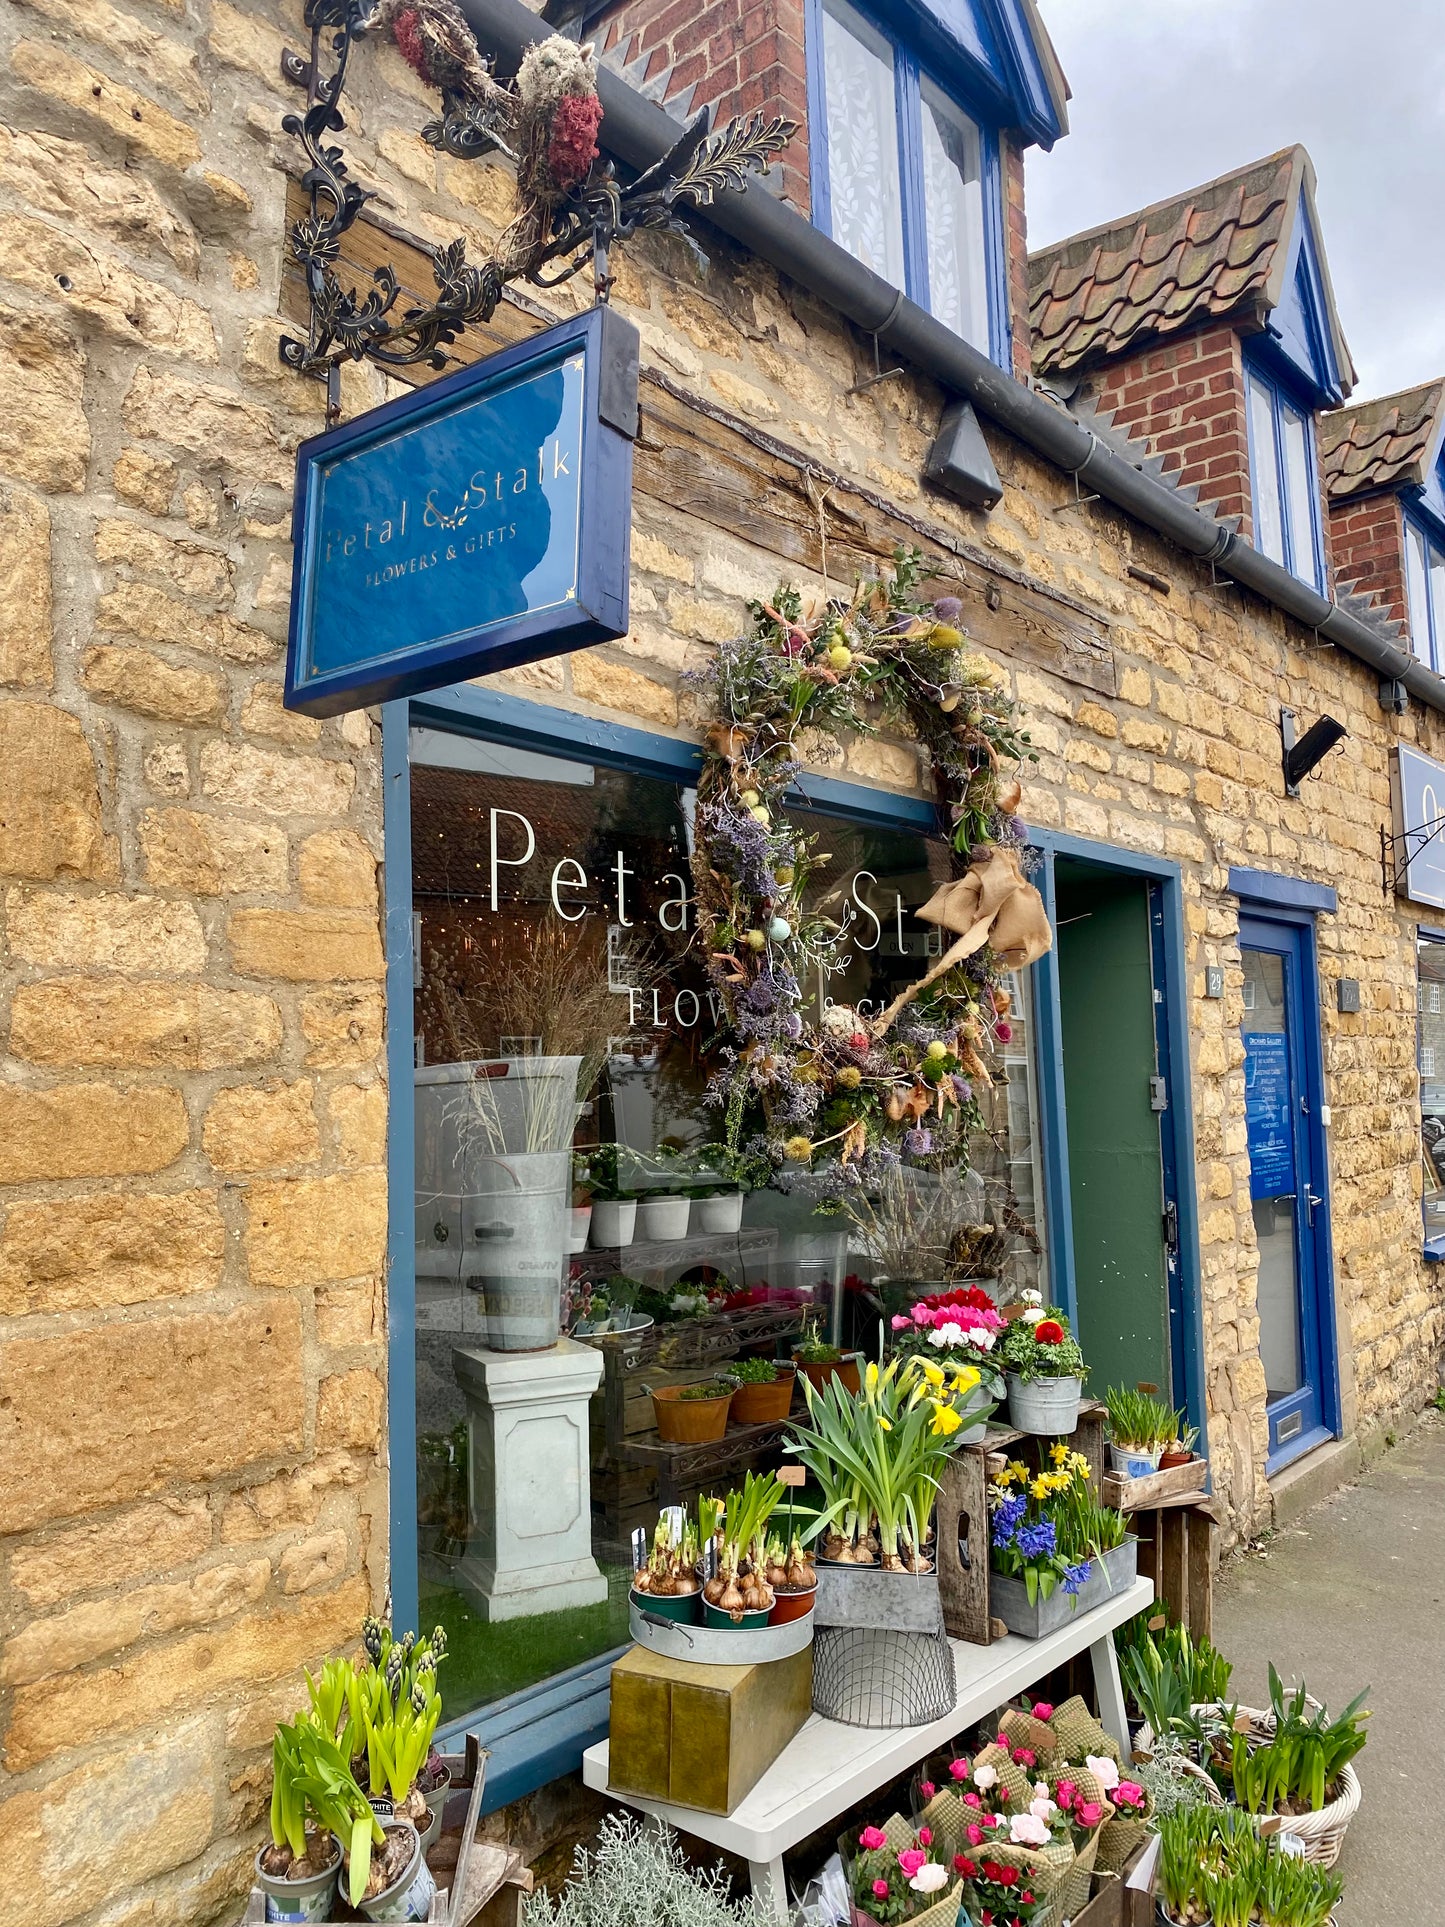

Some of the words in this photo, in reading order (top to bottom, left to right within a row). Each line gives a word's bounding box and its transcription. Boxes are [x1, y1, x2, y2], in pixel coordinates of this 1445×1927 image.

[326, 500, 407, 563] Petal
[422, 489, 468, 531] &
[469, 439, 571, 509] Stalk
[366, 550, 437, 587] FLOWERS
[446, 544, 457, 560] &
[465, 522, 517, 553] GIFTS
[490, 807, 688, 932] Peta
[852, 871, 942, 957] Sta
[890, 941, 914, 951] OEN
[1211, 973, 1221, 990] 29
